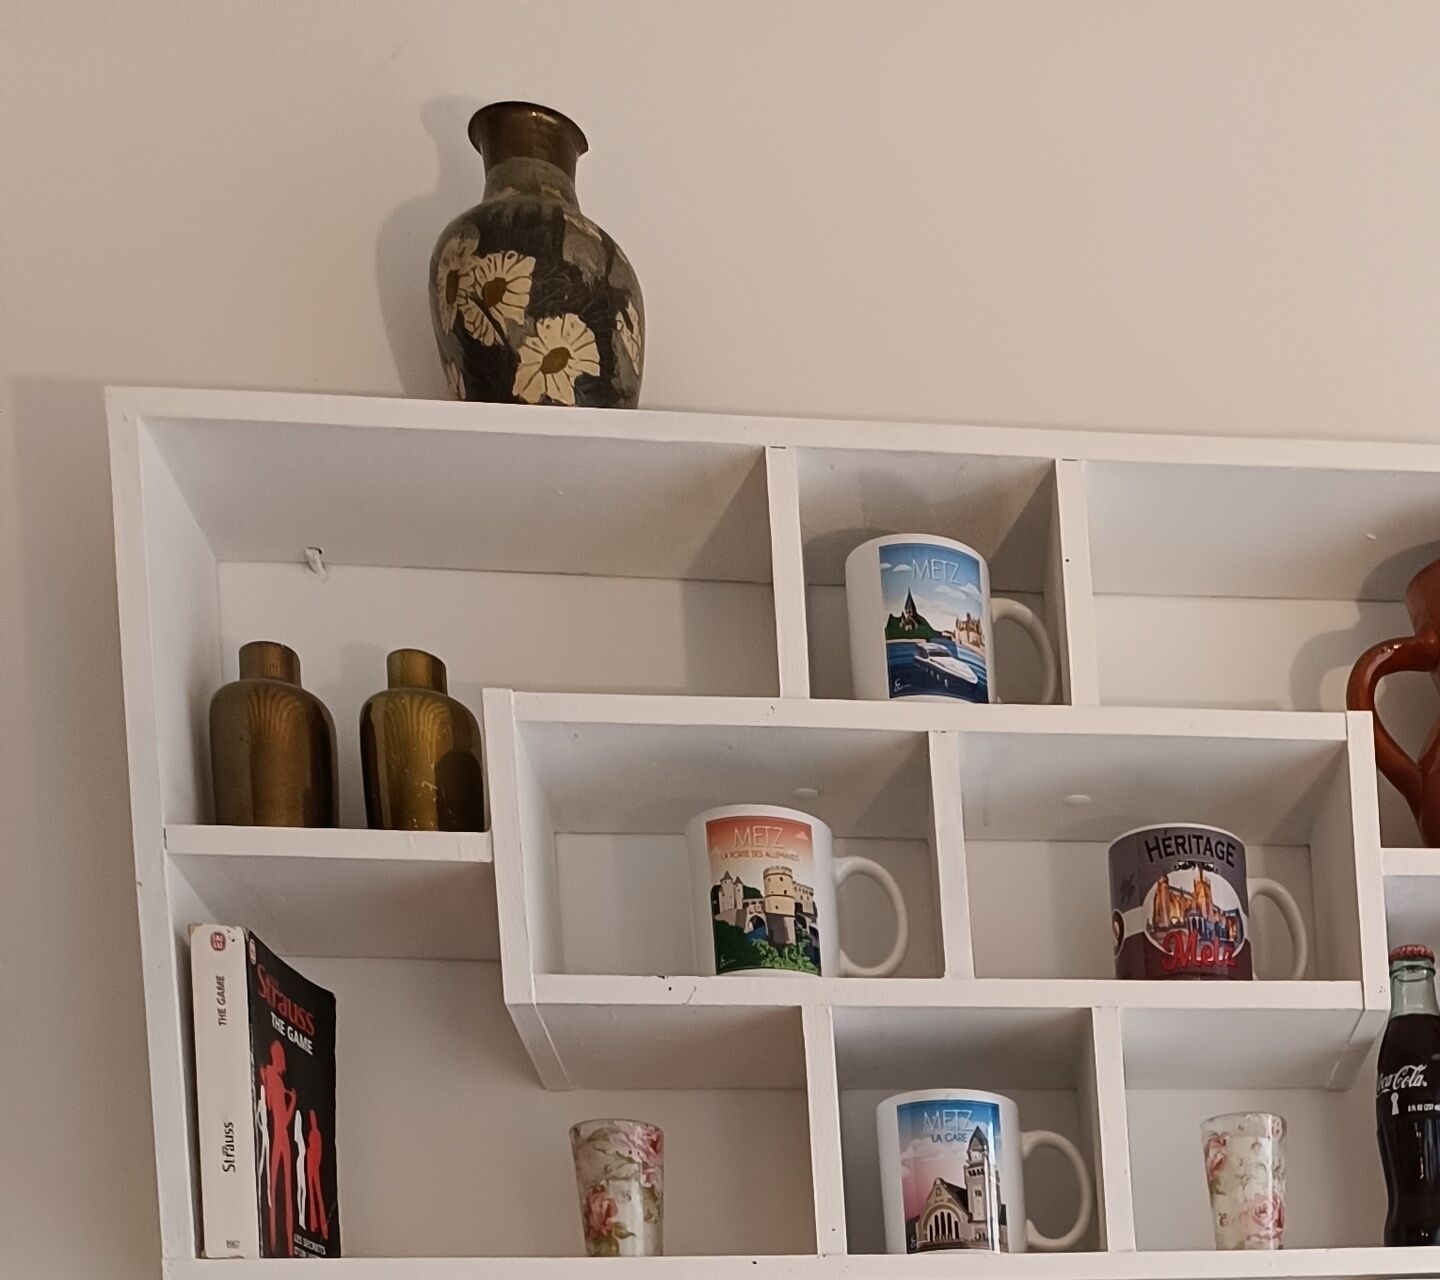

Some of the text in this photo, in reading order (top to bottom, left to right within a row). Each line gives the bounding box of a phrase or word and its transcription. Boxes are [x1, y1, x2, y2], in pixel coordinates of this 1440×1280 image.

[912, 559, 959, 583] METZ
[734, 826, 784, 849] METZ
[1144, 830, 1236, 868] HÉRITAGE
[1162, 929, 1237, 971] Metz
[217, 975, 227, 1027] THE GAME
[257, 963, 315, 1038] Strauss
[270, 1012, 313, 1055] THE GAME
[923, 1109, 974, 1132] METZ
[932, 1134, 943, 1143] LA
[222, 1121, 236, 1173] Strauss
